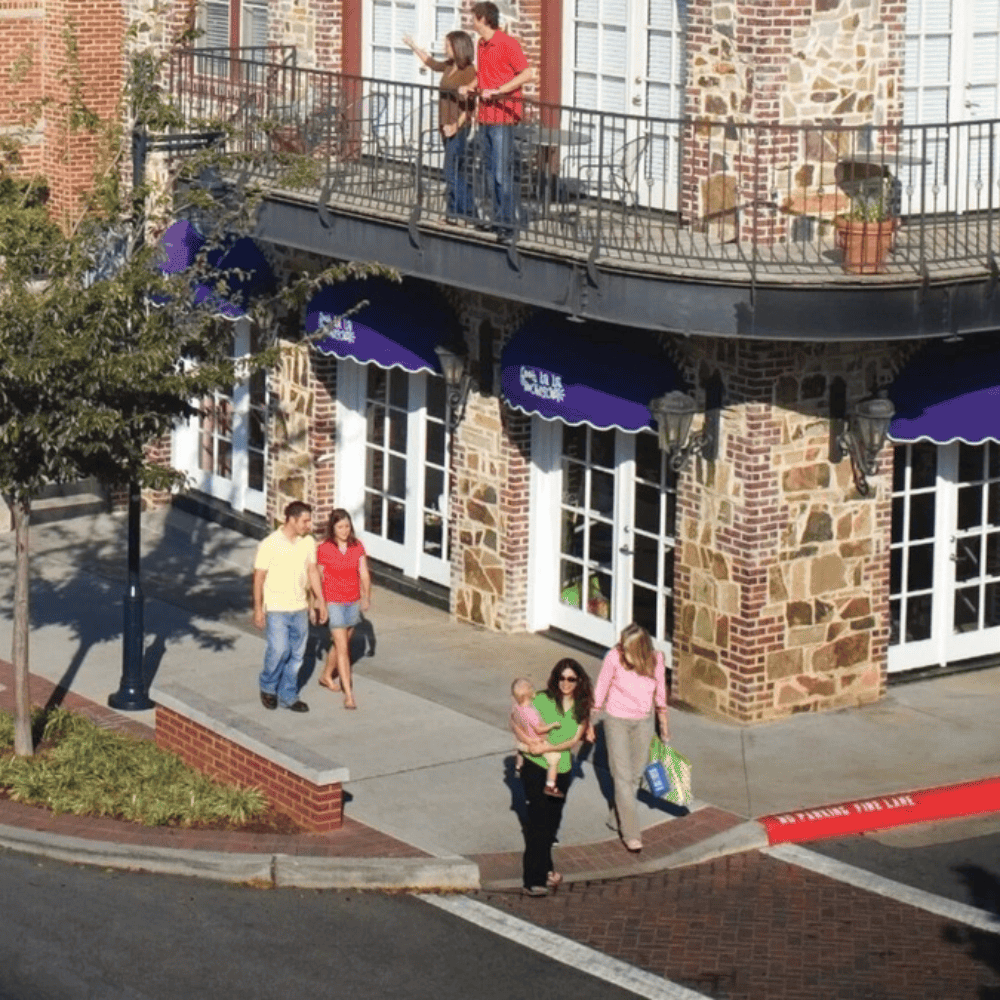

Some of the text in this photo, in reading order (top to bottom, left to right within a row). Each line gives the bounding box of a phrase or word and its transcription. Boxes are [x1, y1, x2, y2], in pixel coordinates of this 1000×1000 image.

[796, 806, 850, 820] PARKING
[853, 800, 883, 813] FIRE
[883, 796, 915, 809] LANE
